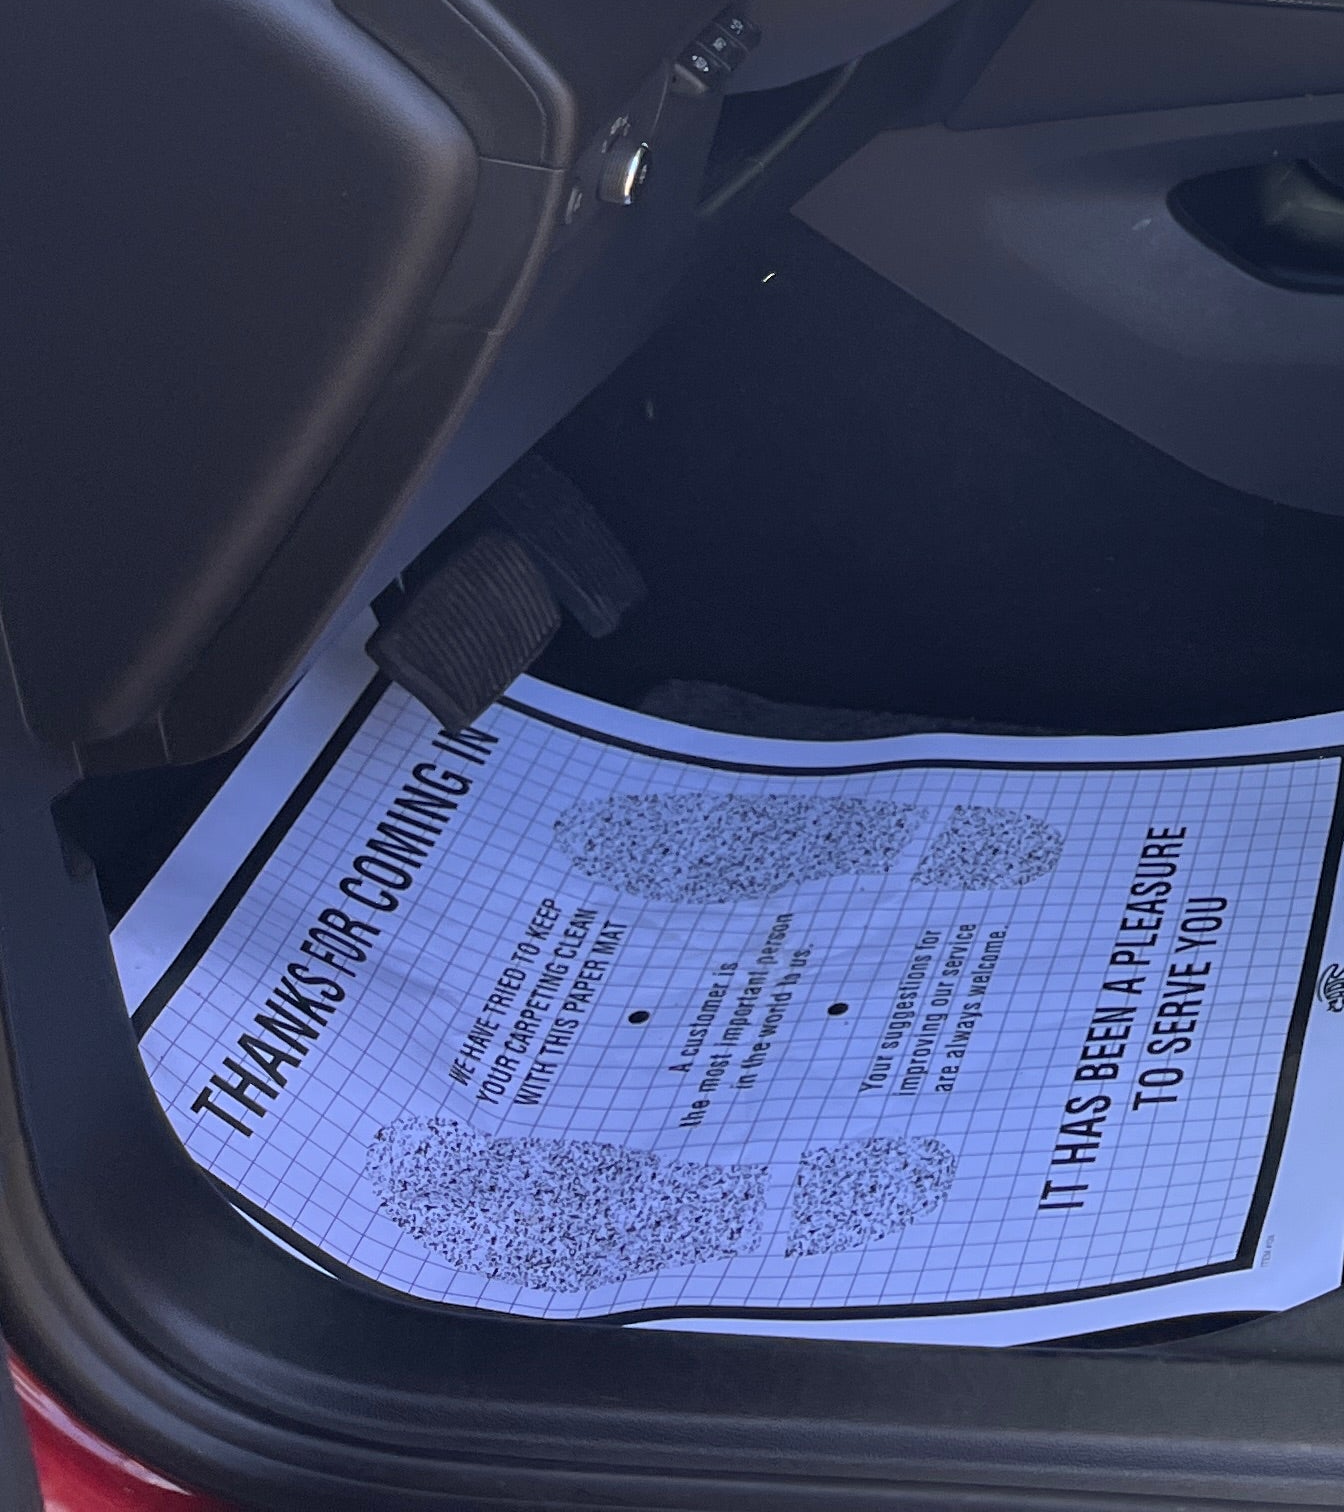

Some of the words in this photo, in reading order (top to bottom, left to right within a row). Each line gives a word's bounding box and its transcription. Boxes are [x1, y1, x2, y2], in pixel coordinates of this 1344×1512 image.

[432, 728, 499, 765] IN
[339, 763, 473, 913] COMING
[525, 898, 562, 940] KEEP
[1109, 827, 1187, 966] PLEASURE
[301, 908, 380, 978] FOR
[757, 913, 794, 965] person
[1175, 897, 1228, 953] YOU
[511, 942, 540, 963] TO
[789, 943, 814, 968] us.
[942, 924, 976, 976] service
[968, 926, 1009, 997] welcome.
[483, 968, 527, 1015] TRIED
[776, 972, 801, 986] to
[931, 982, 954, 1007] our
[1102, 976, 1146, 995] A
[476, 1055, 520, 1105] YOUR
[504, 963, 569, 1054] CARPETING
[554, 907, 598, 960] CLEAN
[513, 1061, 558, 1106] WITH
[539, 1018, 580, 1055] THIS
[562, 960, 609, 1013] PAPER
[592, 920, 627, 955] MAT
[668, 1062, 693, 1073] A
[681, 982, 729, 1057] customer
[713, 962, 738, 976] is
[714, 971, 769, 1047] important
[759, 991, 792, 1038] world
[858, 1055, 894, 1092] Your
[881, 955, 932, 1049] suggestions
[915, 930, 942, 950] for
[944, 1002, 982, 1059] always
[1147, 961, 1211, 1055] SERVE
[191, 962, 345, 1138] THANKS
[459, 1017, 499, 1061] HAVE
[741, 1042, 771, 1069] the
[892, 1013, 948, 1096] improving
[1074, 1006, 1137, 1082] BEEN
[449, 1058, 475, 1086] WE
[699, 1053, 732, 1093] most
[729, 1072, 758, 1089] in
[935, 1066, 960, 1093] are
[1132, 1067, 1185, 1111] TO
[679, 1098, 711, 1128] the
[1051, 1095, 1112, 1165] HAS
[1038, 1180, 1089, 1210] IT
